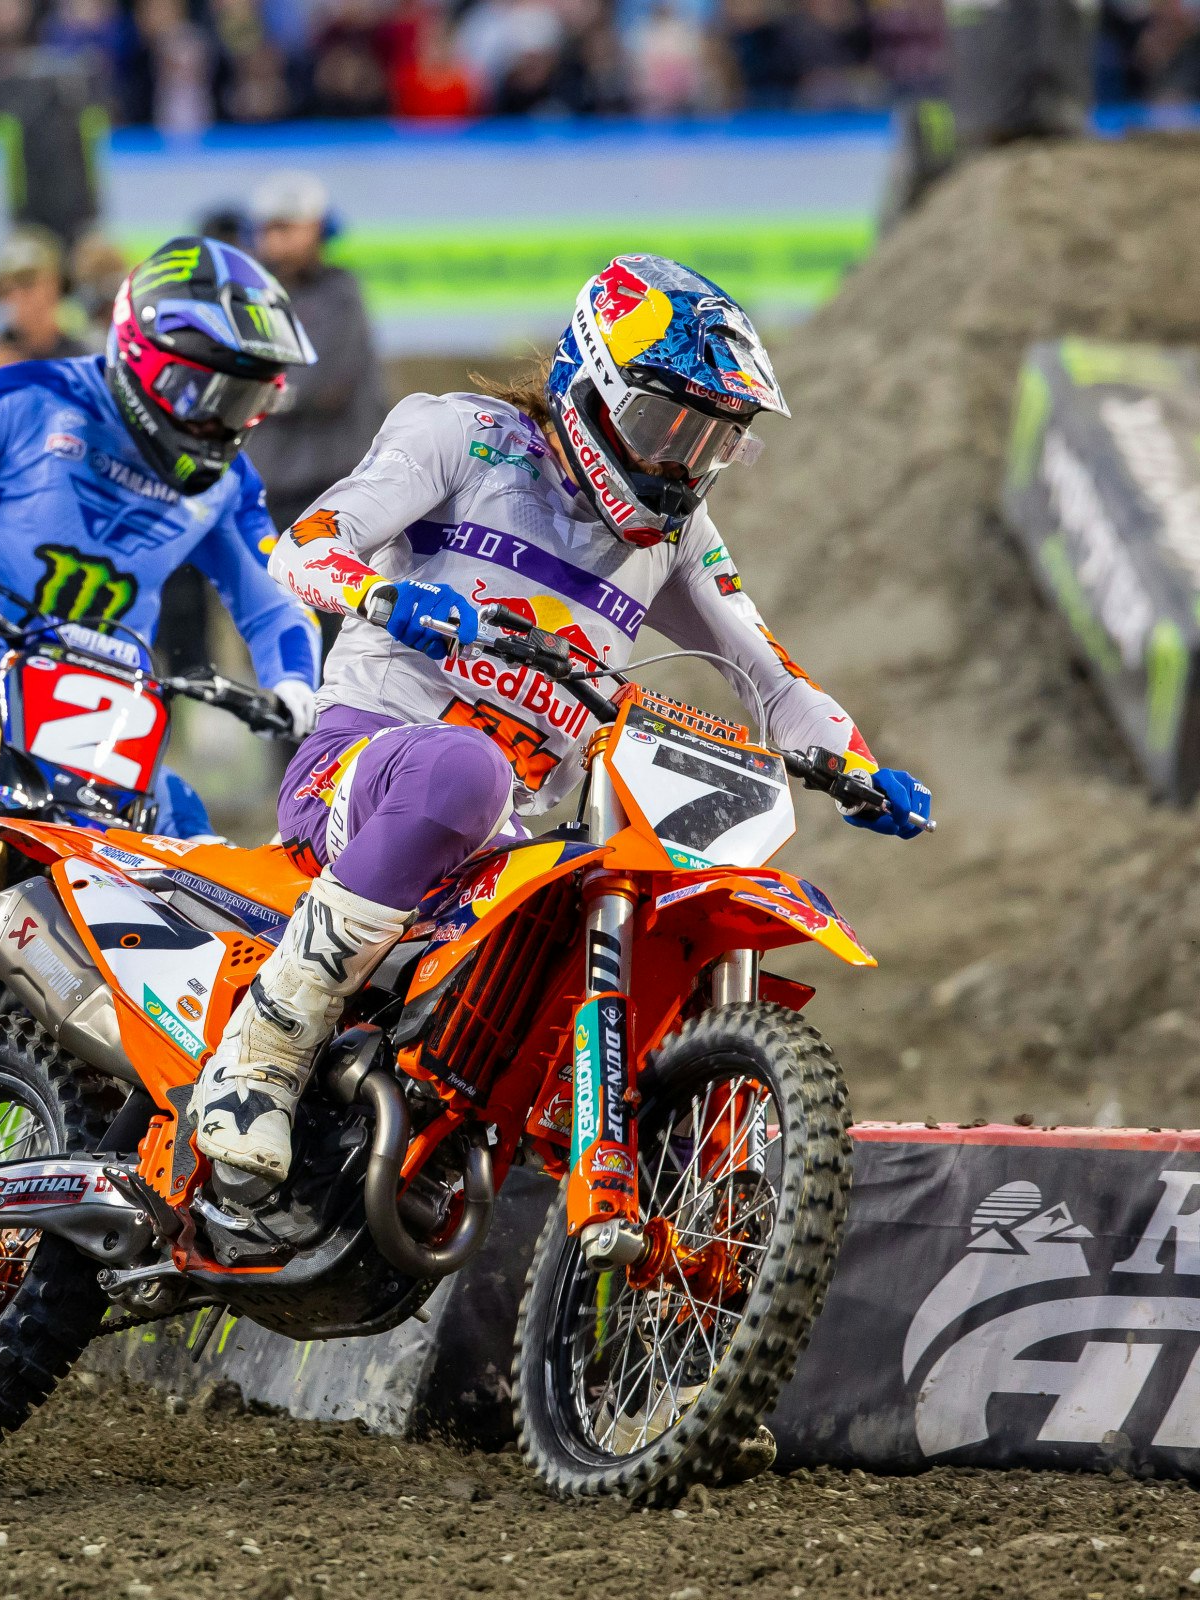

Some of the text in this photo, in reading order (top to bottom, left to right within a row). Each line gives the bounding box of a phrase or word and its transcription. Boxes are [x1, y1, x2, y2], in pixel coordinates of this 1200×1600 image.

[576, 309, 613, 387] OAKLEY
[612, 391, 632, 417] OAKLEY
[562, 405, 602, 472] Red
[407, 579, 442, 596] THOR
[443, 651, 591, 740] Red Bull
[641, 697, 743, 744] RENTHAL
[30, 673, 157, 790] 2
[669, 728, 743, 761] SUPERCROSS
[651, 743, 781, 853] 7
[97, 846, 145, 868] PROGRESSIVE
[171, 870, 280, 926] LOMA LINDA UNIVERSITY HEALTH
[157, 1010, 203, 1057] MOTOREX
[448, 1072, 467, 1090] Twin
[576, 1049, 595, 1142] MOTOREX
